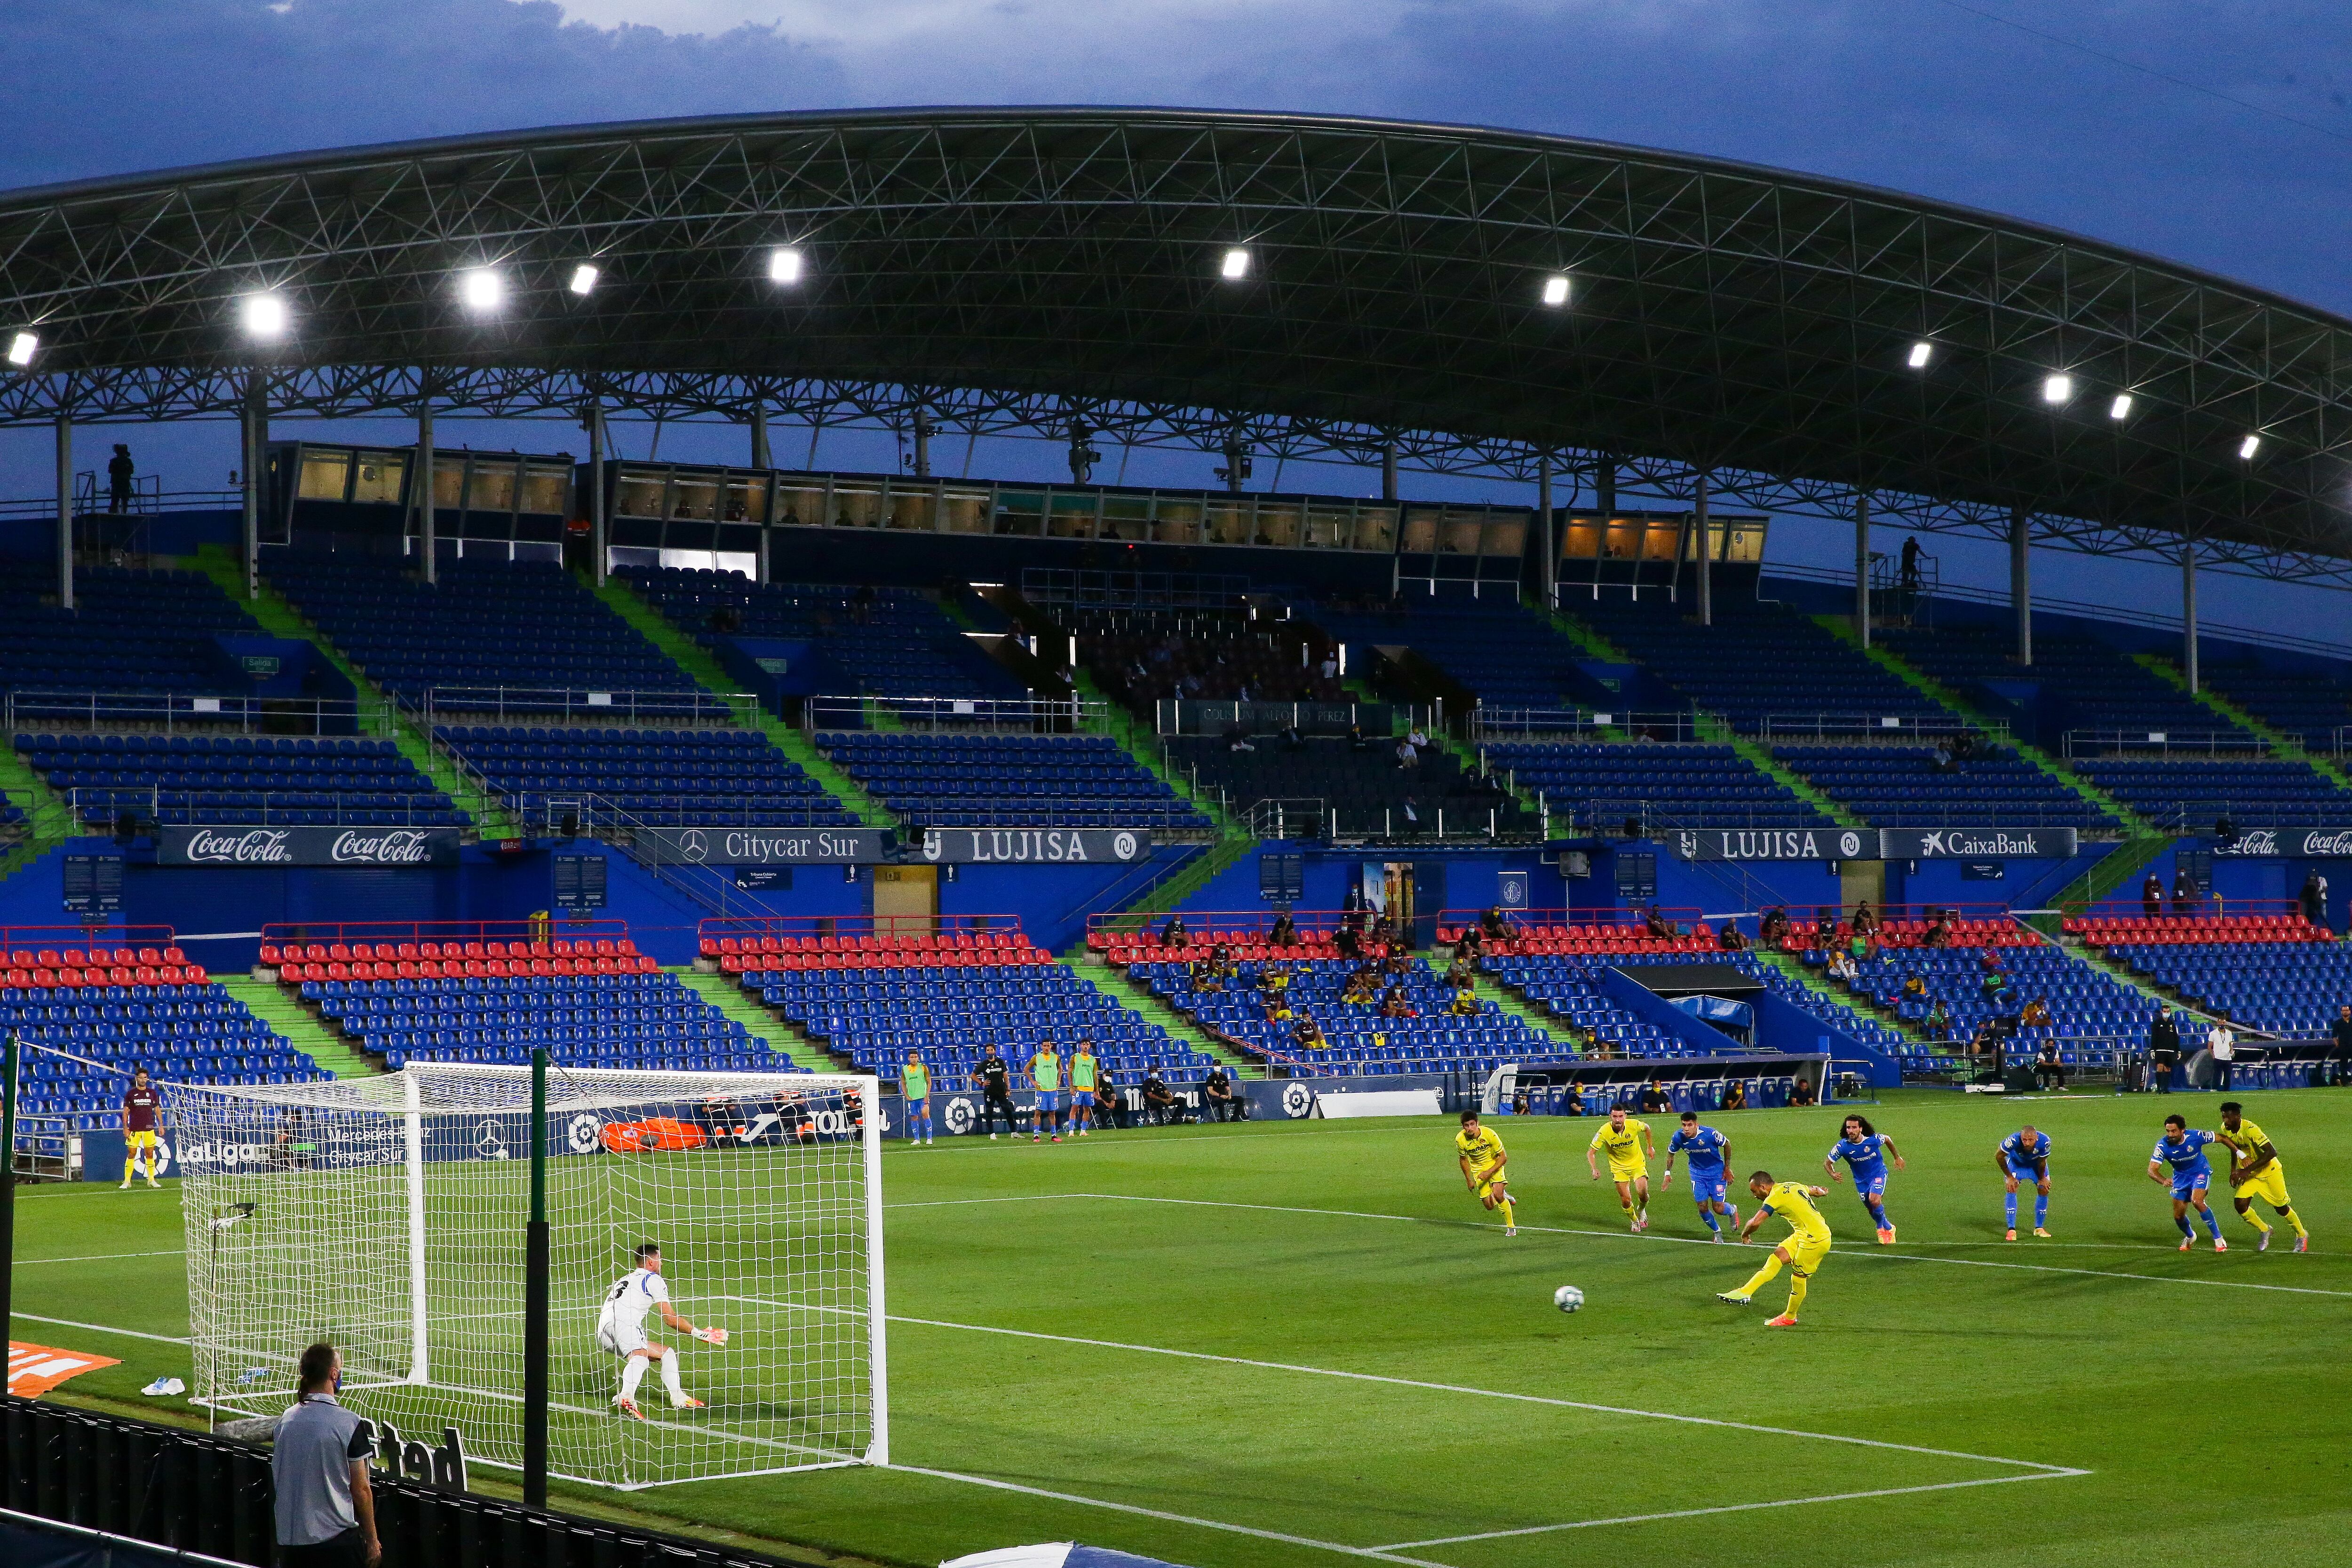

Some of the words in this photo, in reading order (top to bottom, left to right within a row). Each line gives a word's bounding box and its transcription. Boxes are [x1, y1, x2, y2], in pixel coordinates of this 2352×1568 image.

[187, 830, 290, 861] Coca-Cola
[332, 831, 430, 861] Coca-Cola
[726, 833, 810, 862] Citycar
[819, 833, 858, 856] Sur
[971, 832, 1087, 860] LUJISA
[1722, 832, 1820, 858] LUJISA
[1948, 832, 2038, 854] CaixaBank
[329, 1126, 431, 1141] Mercedes-Bz
[176, 1138, 256, 1166] LaLiga
[330, 1150, 377, 1166] Citycar
[381, 1148, 404, 1160] Sur
